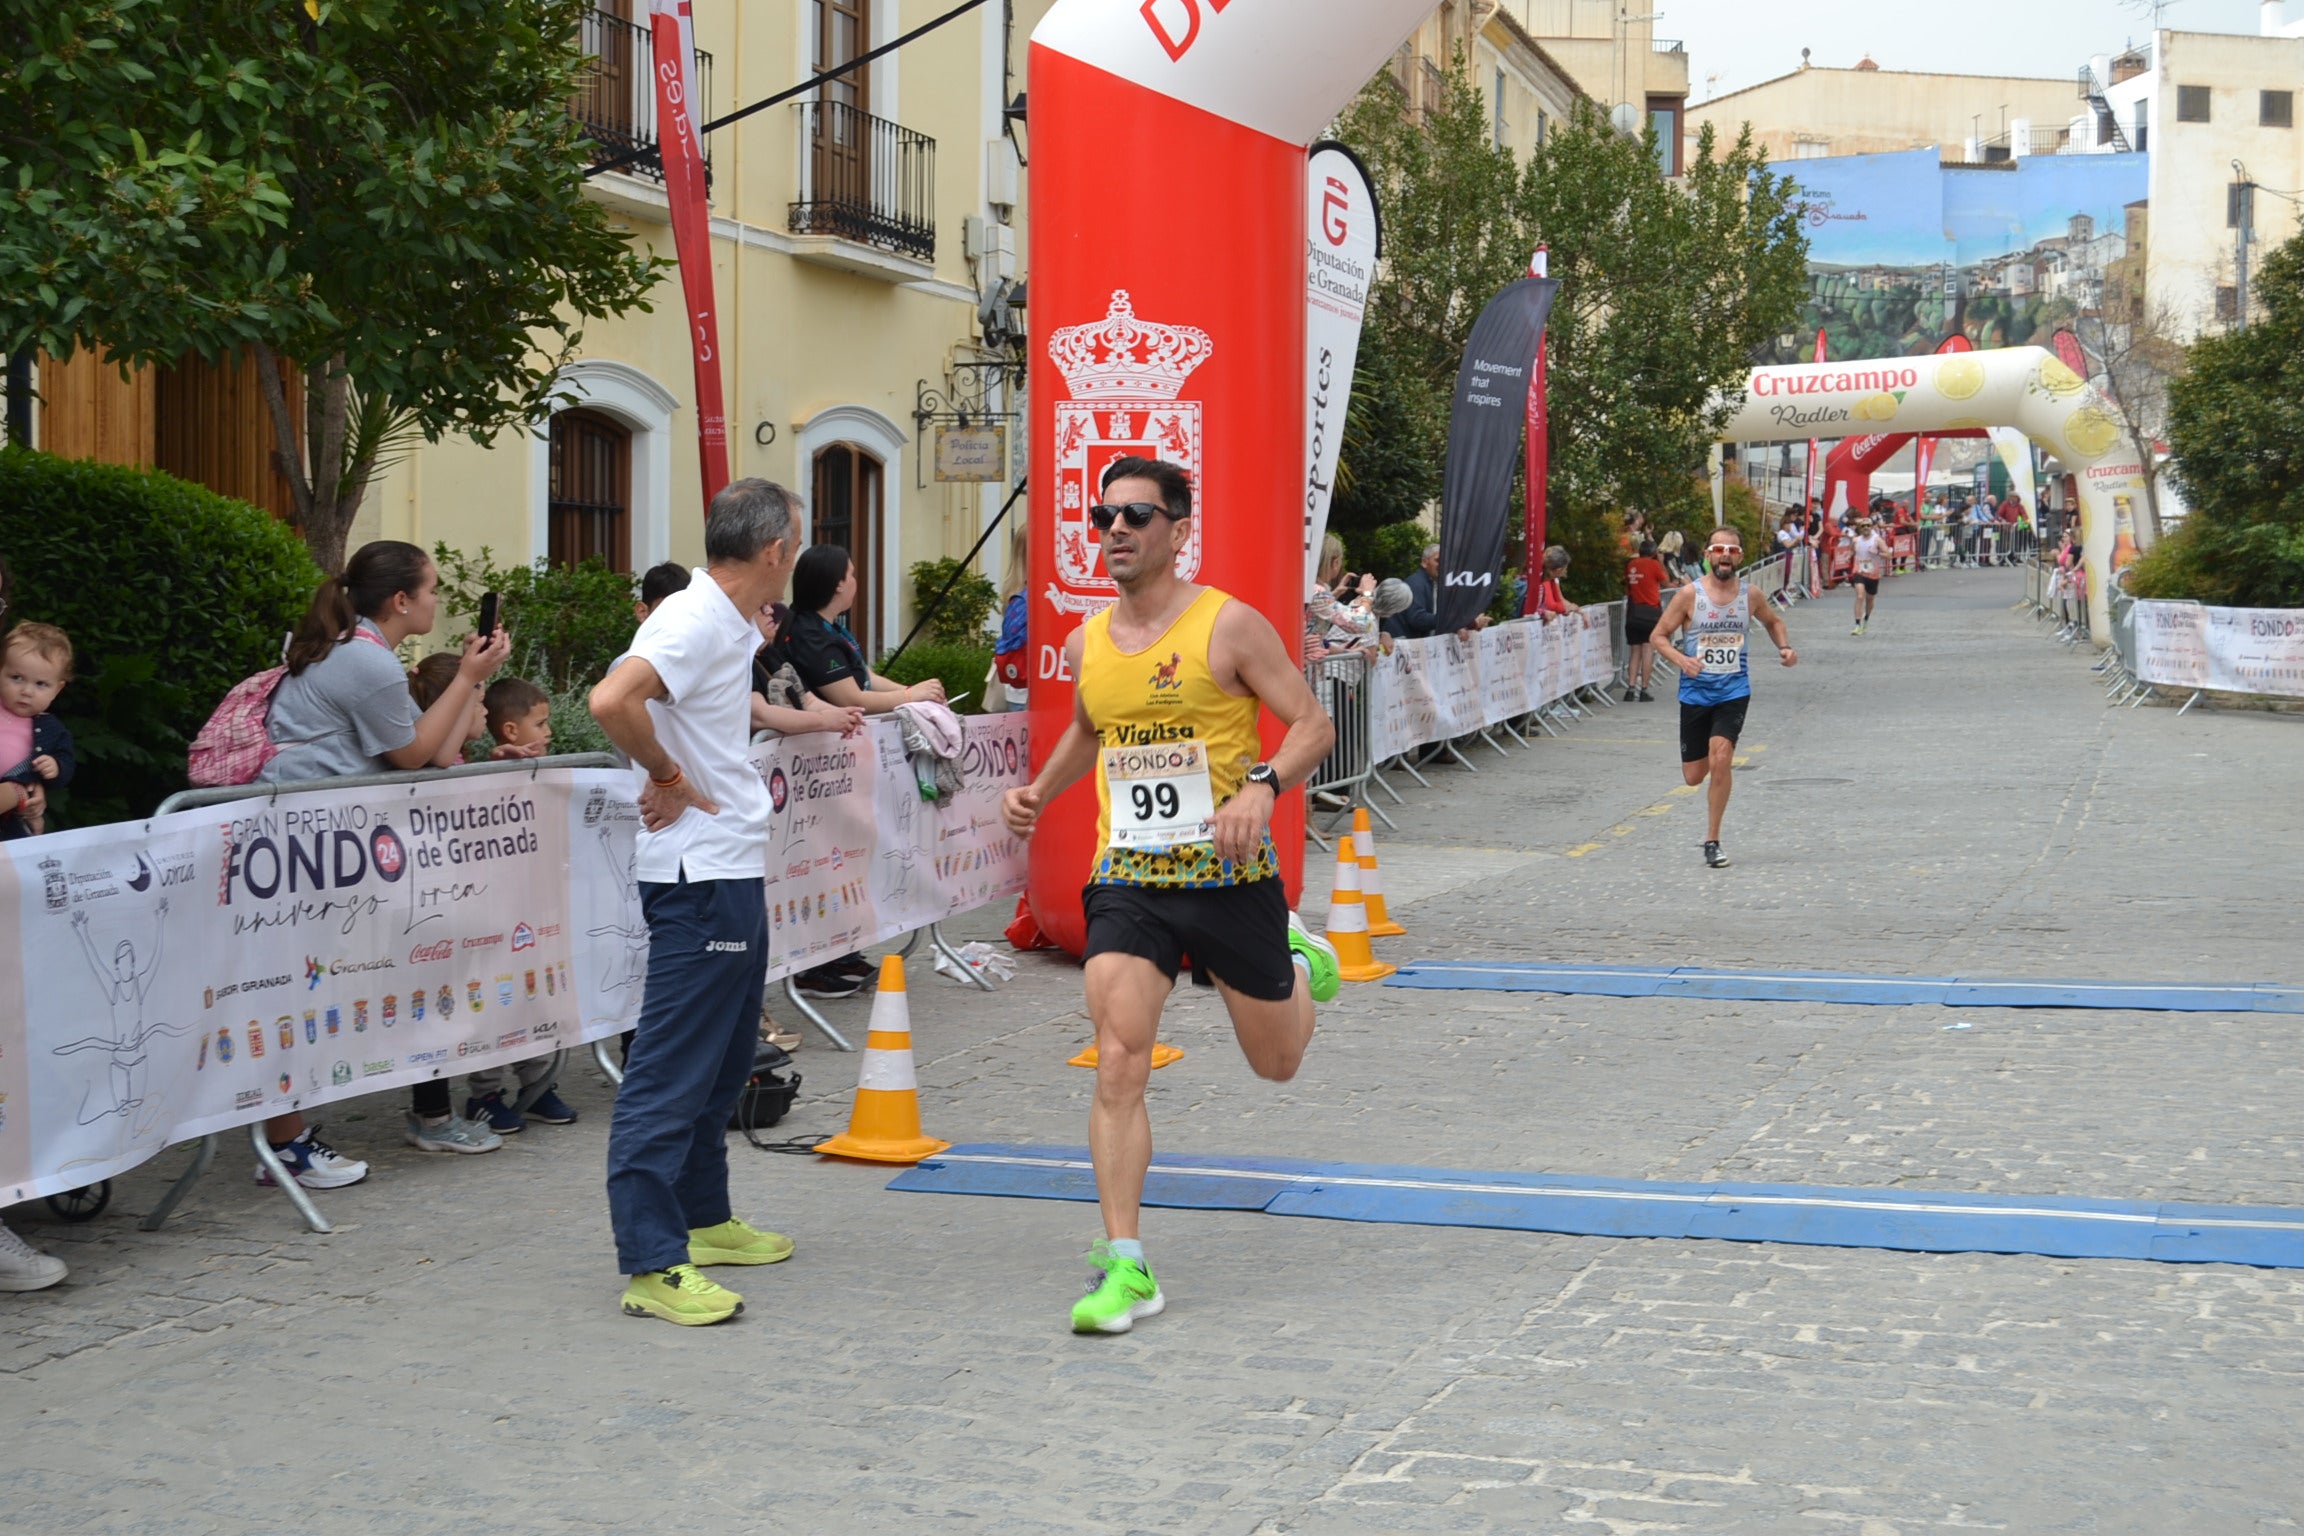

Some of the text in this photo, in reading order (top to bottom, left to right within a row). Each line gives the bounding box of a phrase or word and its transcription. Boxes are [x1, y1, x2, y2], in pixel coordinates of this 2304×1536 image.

[1800, 185, 1831, 198] Turismo
[1307, 238, 1365, 280] Diputación
[1317, 269, 1364, 304] Granada
[1471, 375, 1490, 389] that
[1474, 359, 1523, 378] Movement
[1753, 368, 1918, 398] Cruzcampo
[1467, 391, 1502, 407] inspires
[1771, 404, 1850, 428] Radler
[953, 453, 986, 465] Local
[1700, 620, 1744, 629] MARACENA
[1704, 649, 1736, 665] 630
[1115, 721, 1194, 746] Vigilsa
[791, 747, 856, 781] Diputación
[808, 772, 853, 800] Granada
[1131, 782, 1180, 821] 99
[231, 812, 279, 844] GRAN
[287, 804, 368, 834] PREMIO
[409, 795, 536, 840] Diputación
[376, 834, 399, 865] 24
[418, 826, 538, 869] de Granada
[226, 824, 408, 906] FONDO
[233, 847, 488, 935] universo Lorca
[329, 956, 397, 976] Granada
[241, 973, 293, 993] GRANADA
